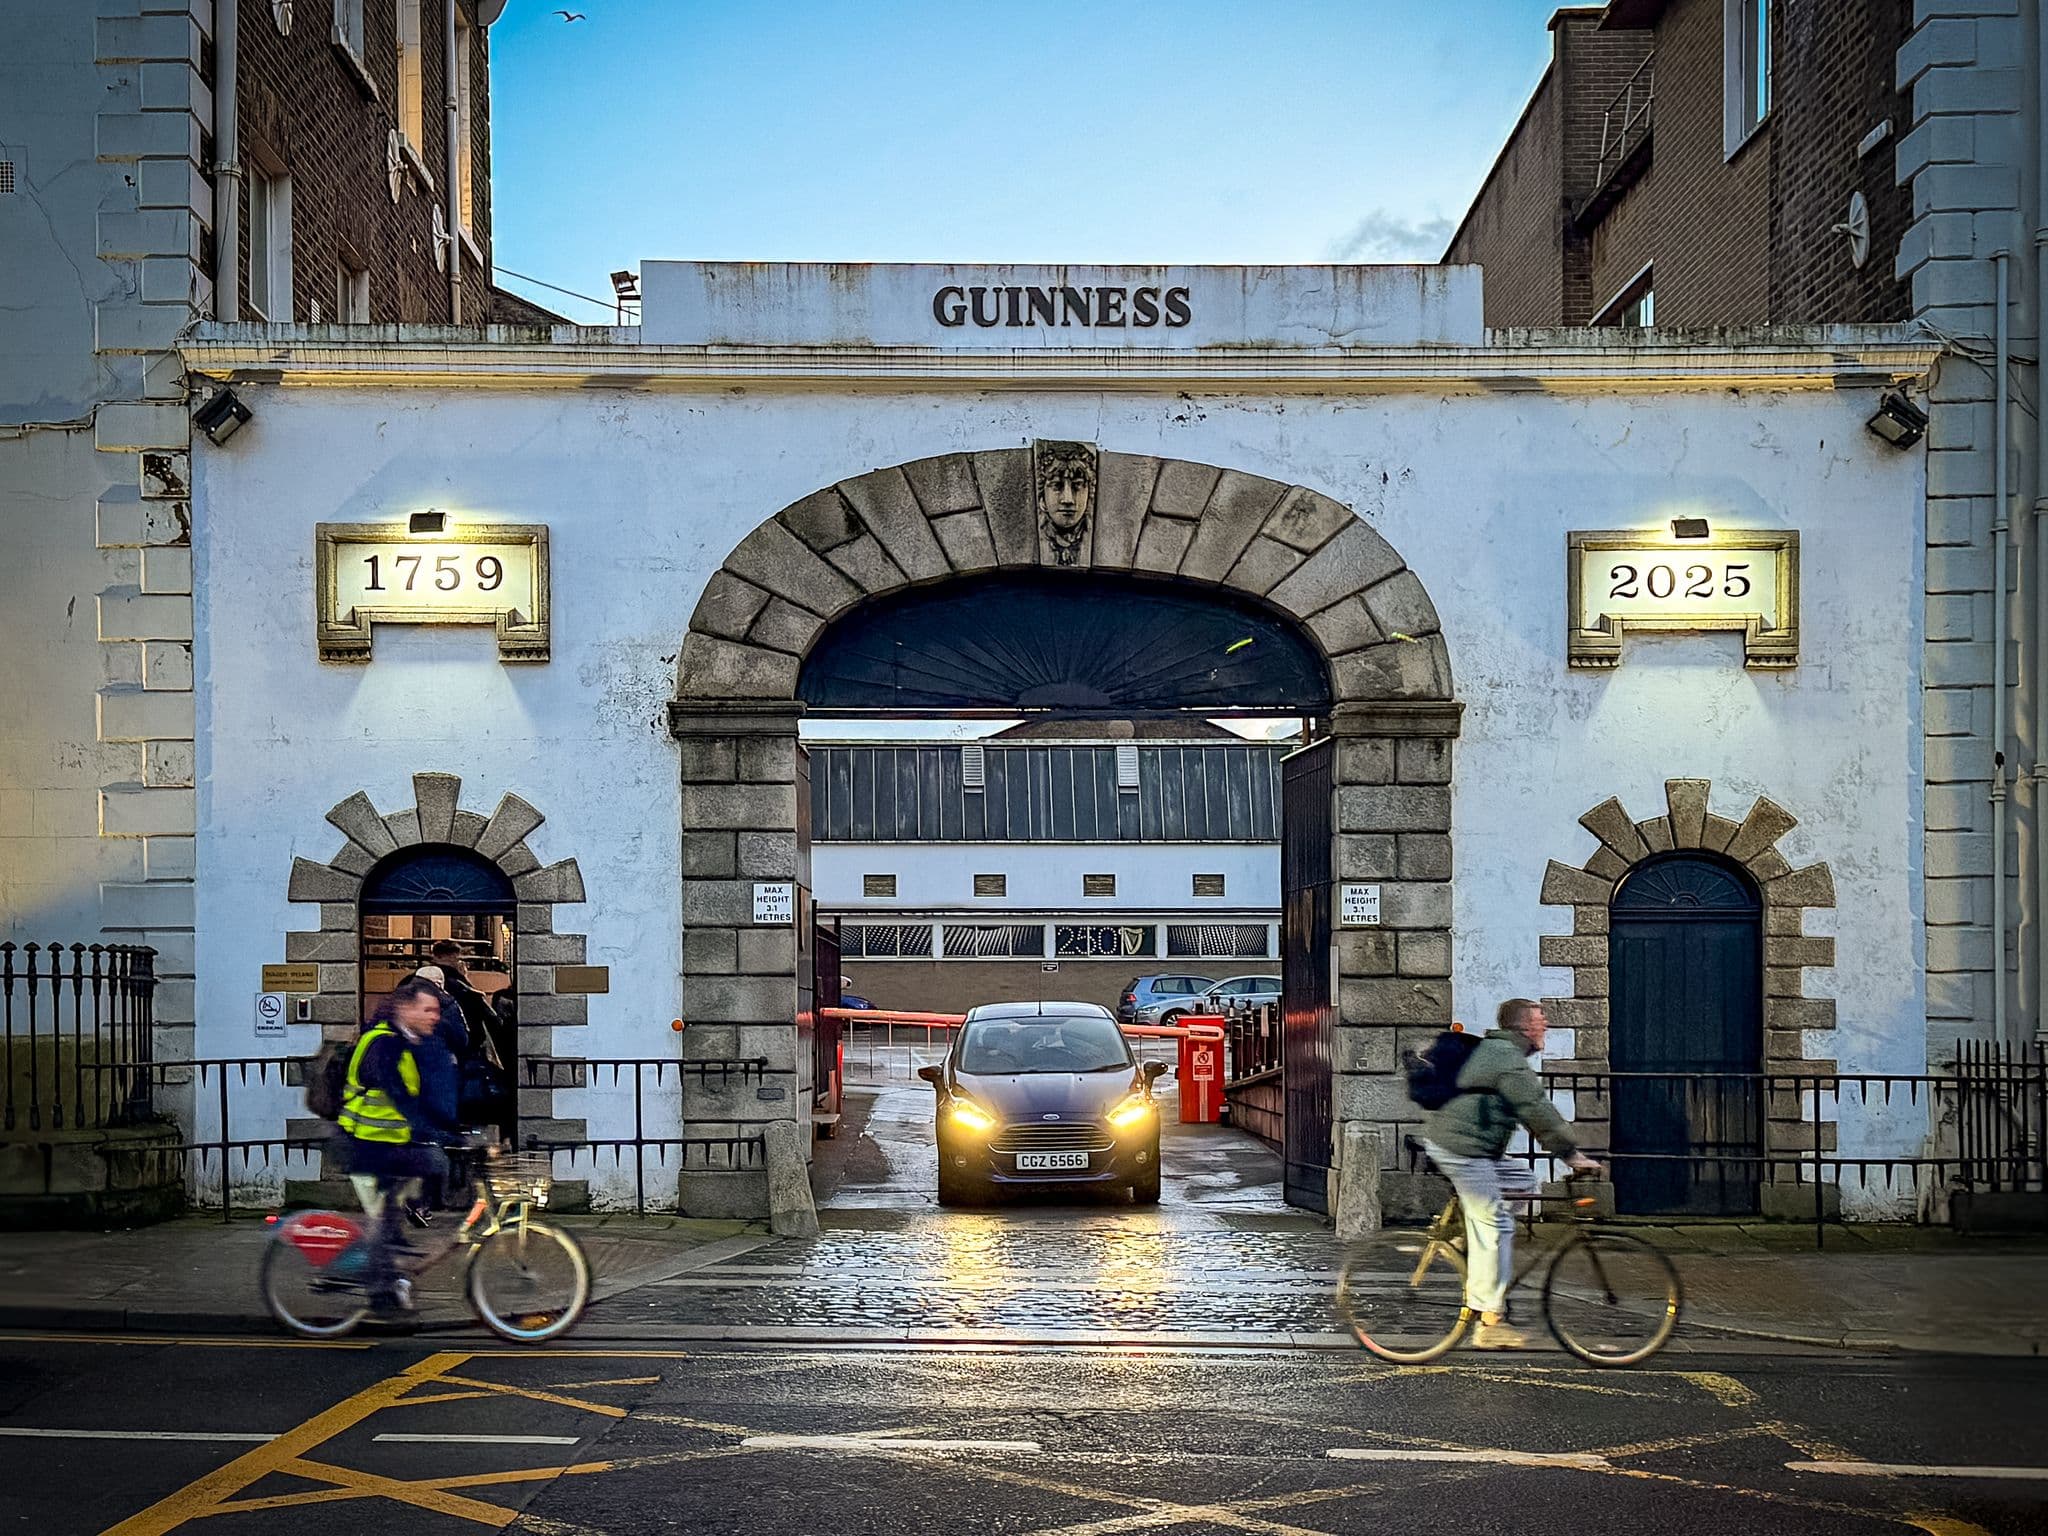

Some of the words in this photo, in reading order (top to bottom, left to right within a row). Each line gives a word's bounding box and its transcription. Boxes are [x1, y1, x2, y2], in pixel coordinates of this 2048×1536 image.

[932, 286, 1192, 327] GUINNESS
[363, 554, 503, 591] 1759
[1609, 564, 1751, 599] 2025
[764, 886, 783, 894] MAX
[1350, 887, 1370, 896] MAX
[756, 895, 790, 903] HEIGHT
[1344, 897, 1378, 905] HEIGHT
[766, 904, 778, 912] 3.1
[755, 913, 791, 921] METRES
[1343, 914, 1378, 922] METRES
[1057, 926, 1118, 955] 250
[1021, 1155, 1047, 1168] CGZ
[1049, 1154, 1084, 1167] 6566
